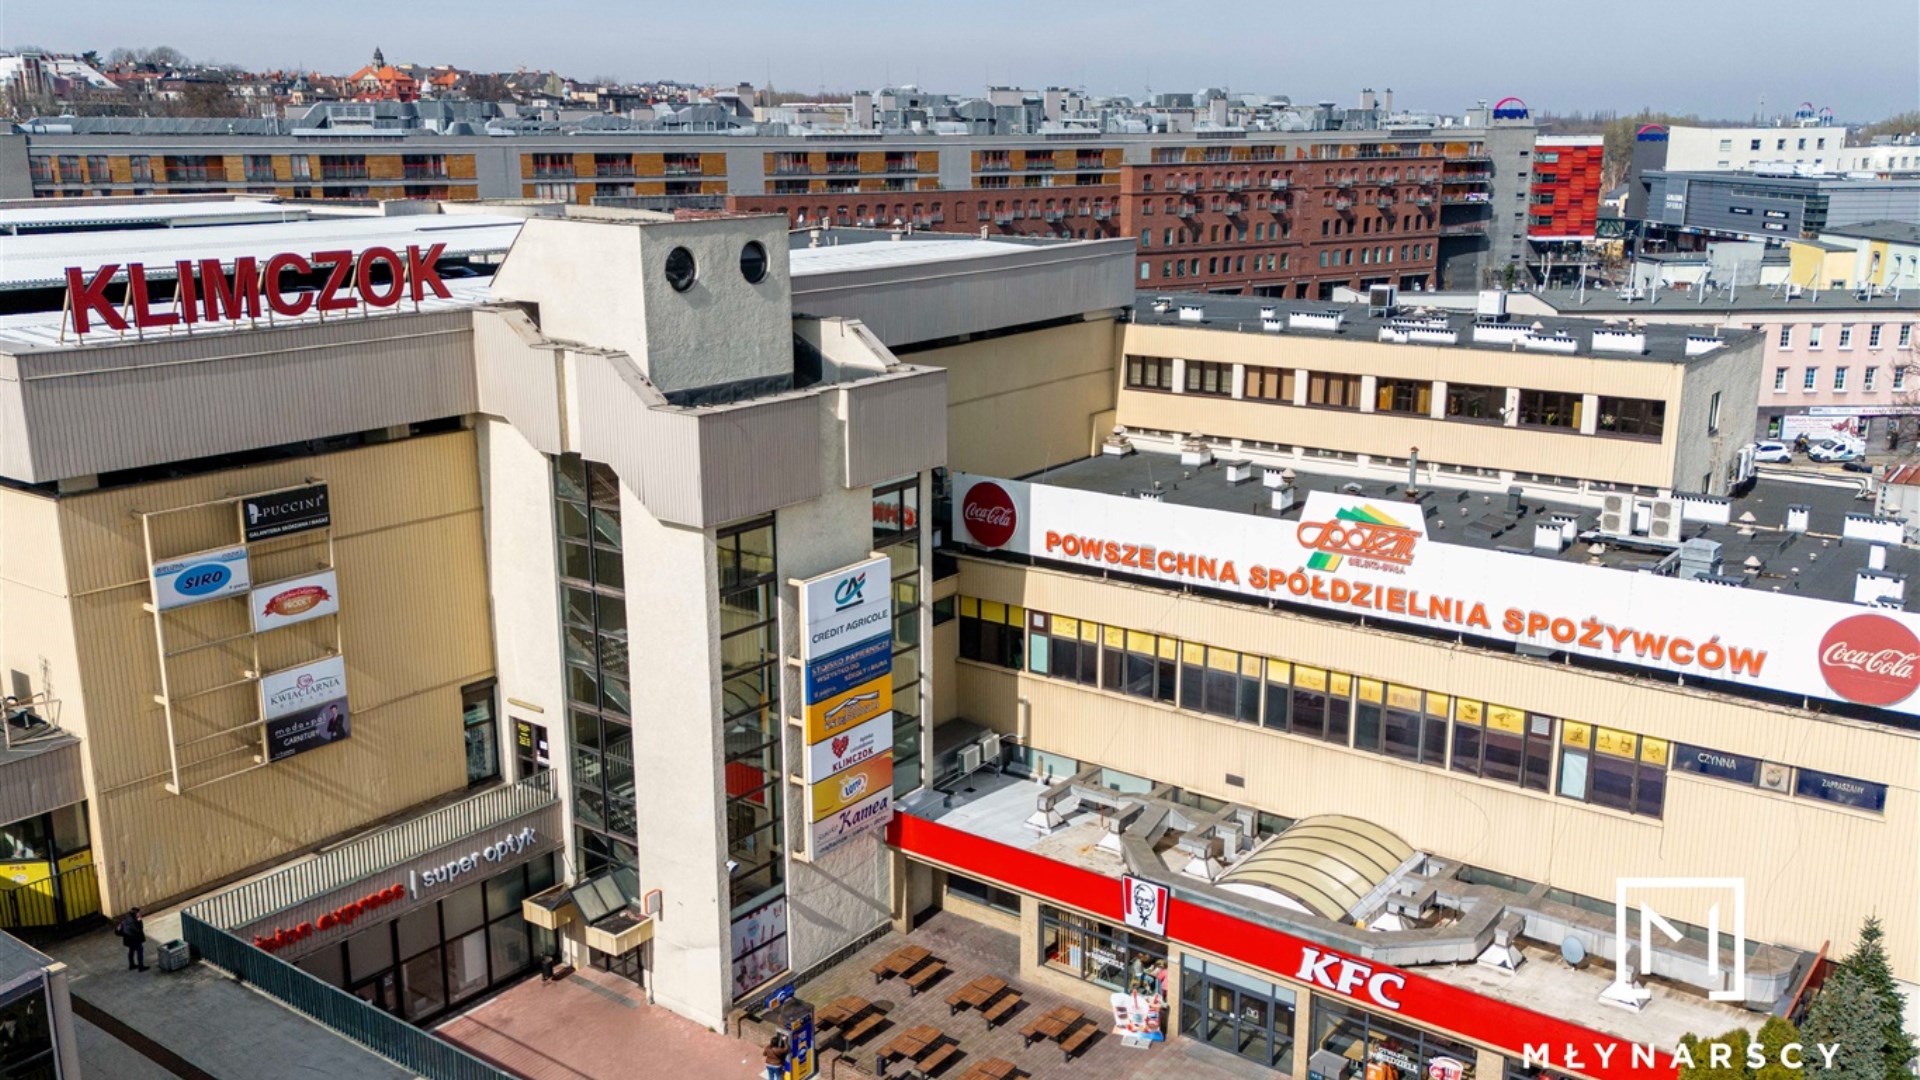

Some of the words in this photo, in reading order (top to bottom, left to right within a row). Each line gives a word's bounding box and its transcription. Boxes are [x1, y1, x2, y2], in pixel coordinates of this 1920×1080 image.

[64, 242, 453, 334] KLIMCZOK
[263, 497, 321, 518] PUCCINI
[965, 502, 1013, 527] Coca-Cola
[1045, 530, 1240, 585] POWSZECHNA
[184, 571, 223, 589] SIRO
[1249, 565, 1491, 629] SPÓŁDZIELNIA
[845, 608, 888, 632] AGRICOLE
[1502, 607, 1769, 678] SPOŻYWCÓW
[1822, 642, 1913, 680] Coca-Cola
[270, 678, 340, 706] KWIACIARNIA
[832, 746, 874, 772] KLIMCZOK
[1697, 752, 1737, 771] CZYNNA
[1821, 778, 1865, 795] ZAPRASZAMY
[838, 796, 889, 835] Kamea
[423, 851, 481, 888] super
[483, 826, 538, 862] optyk
[255, 919, 313, 953] ision
[317, 883, 406, 932] express
[1296, 946, 1406, 1010] KFC
